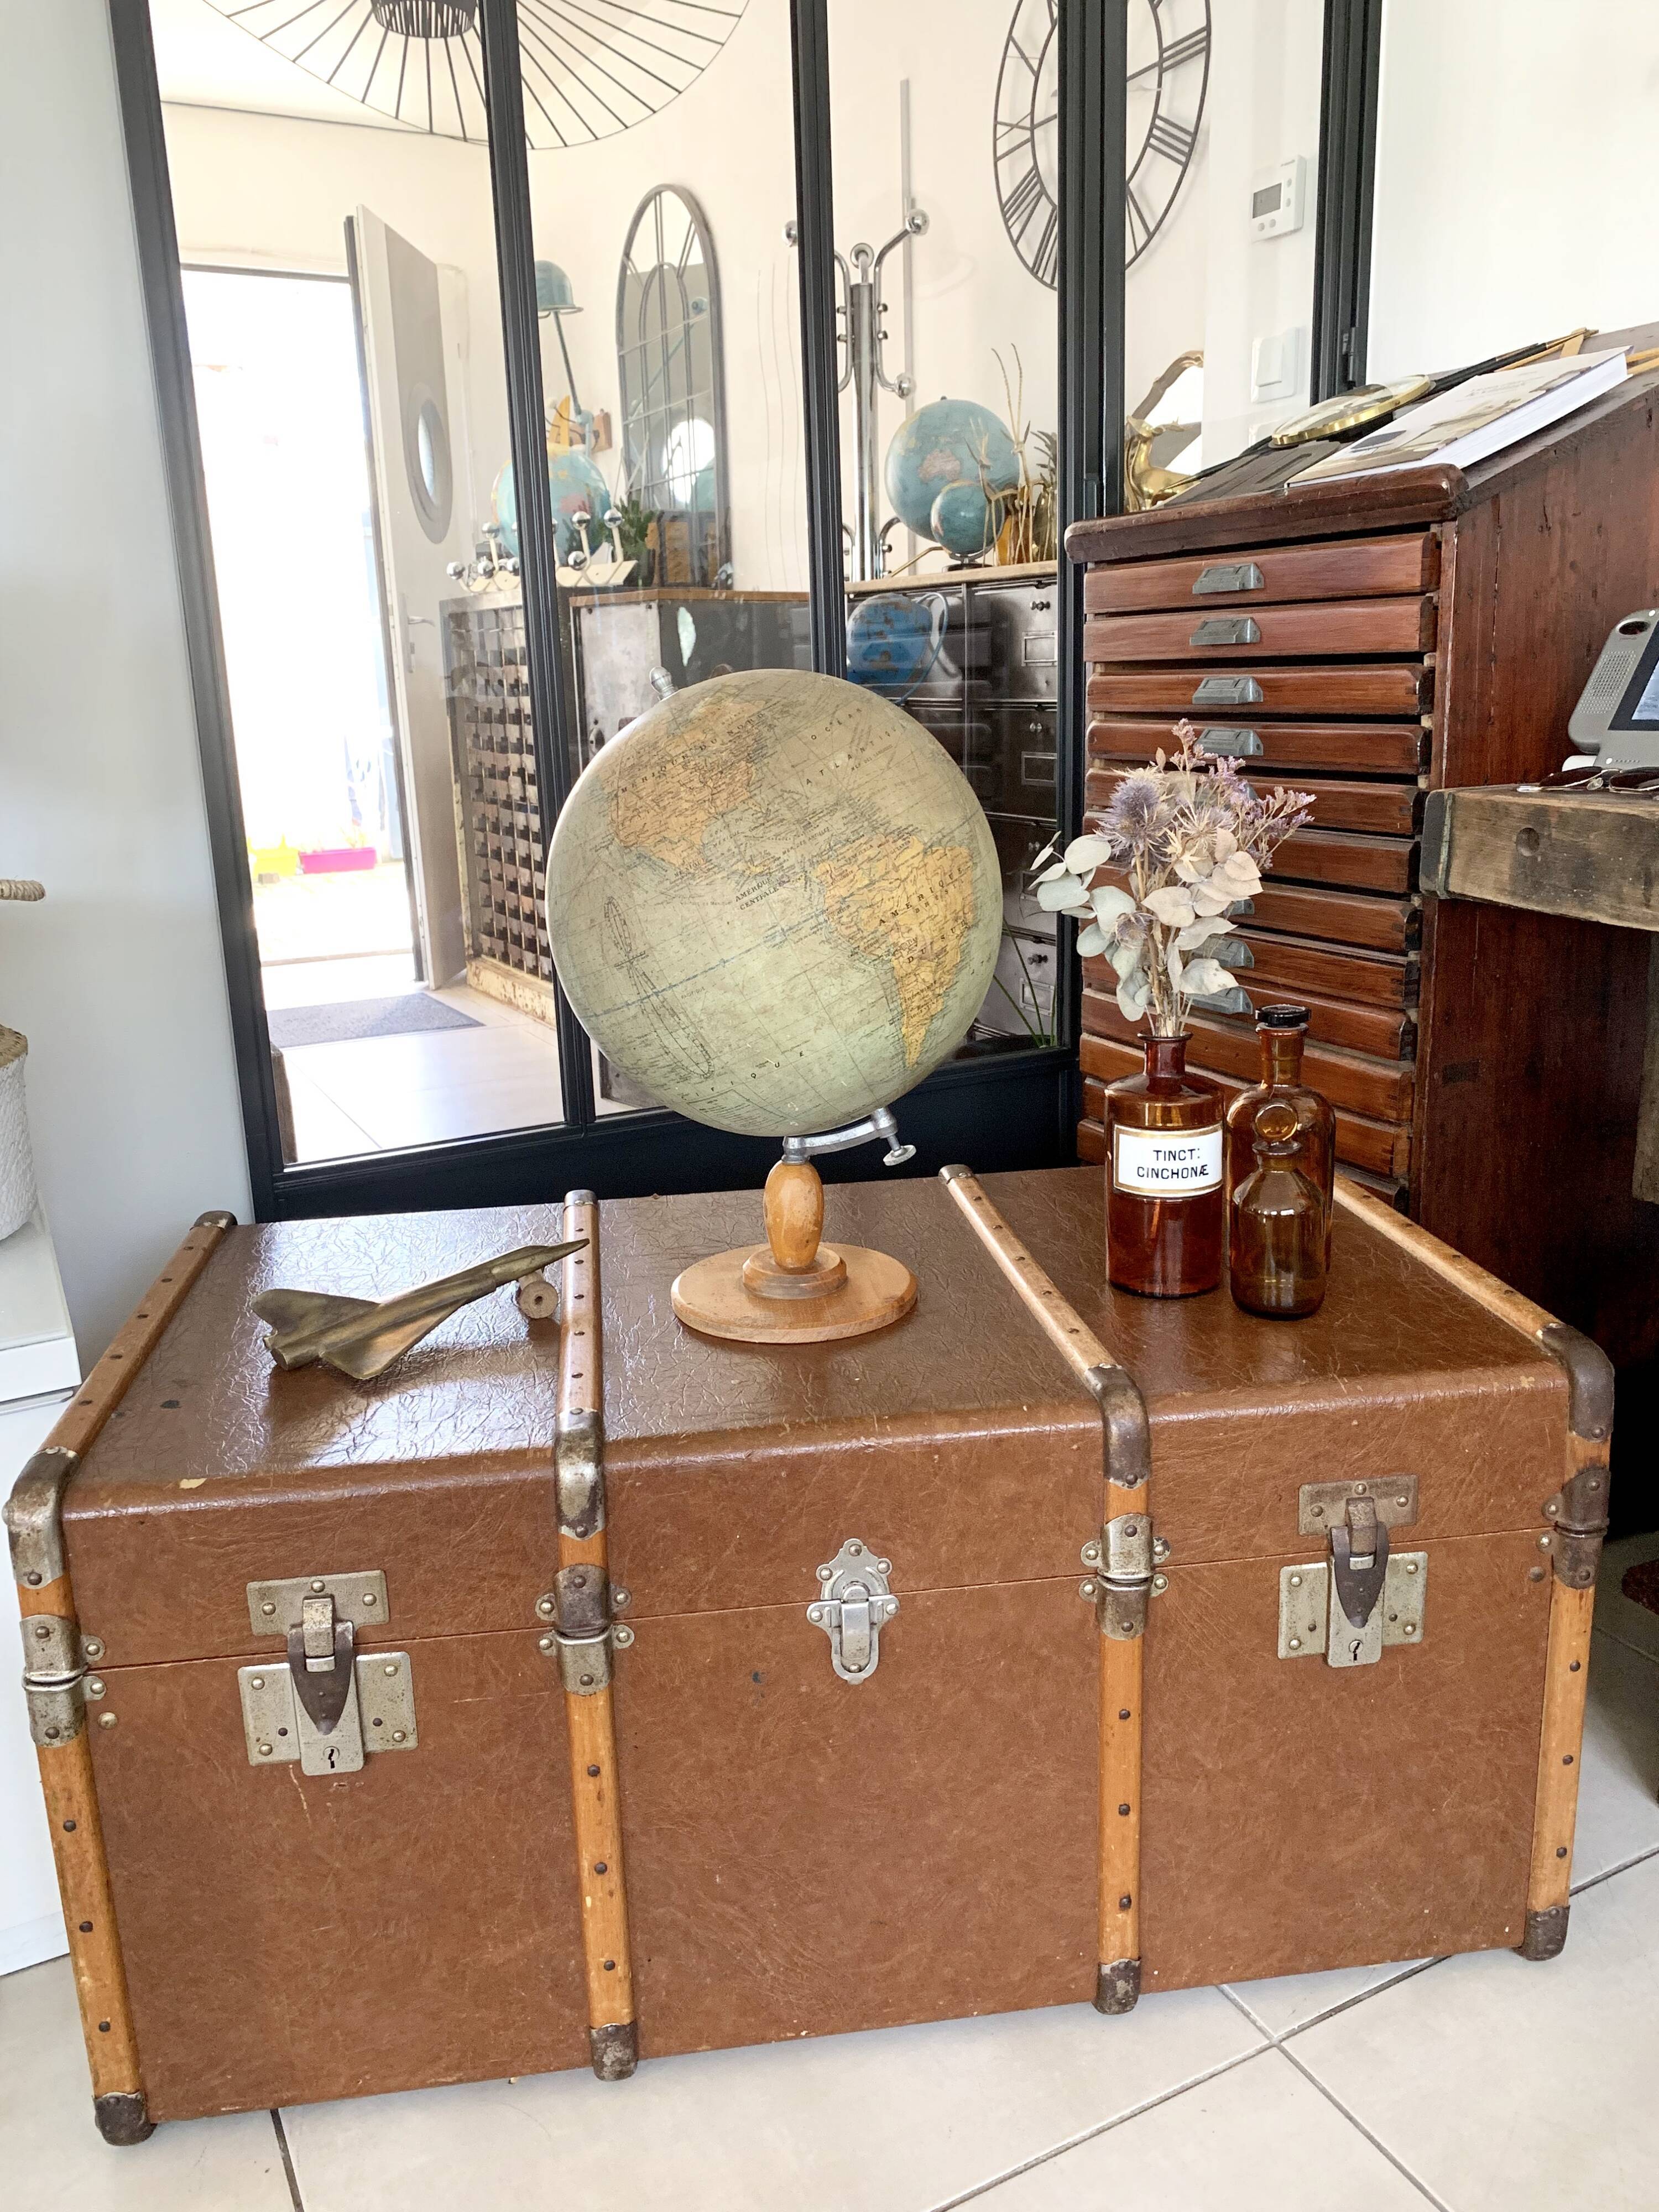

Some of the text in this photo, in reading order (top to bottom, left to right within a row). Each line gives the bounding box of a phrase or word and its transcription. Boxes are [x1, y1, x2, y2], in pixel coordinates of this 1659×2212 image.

[739, 885, 780, 911] CENTRALE
[907, 948, 927, 963] DU
[1153, 1148, 1200, 1161] TINCT:
[1137, 1164, 1209, 1180] CINCHONÆ
